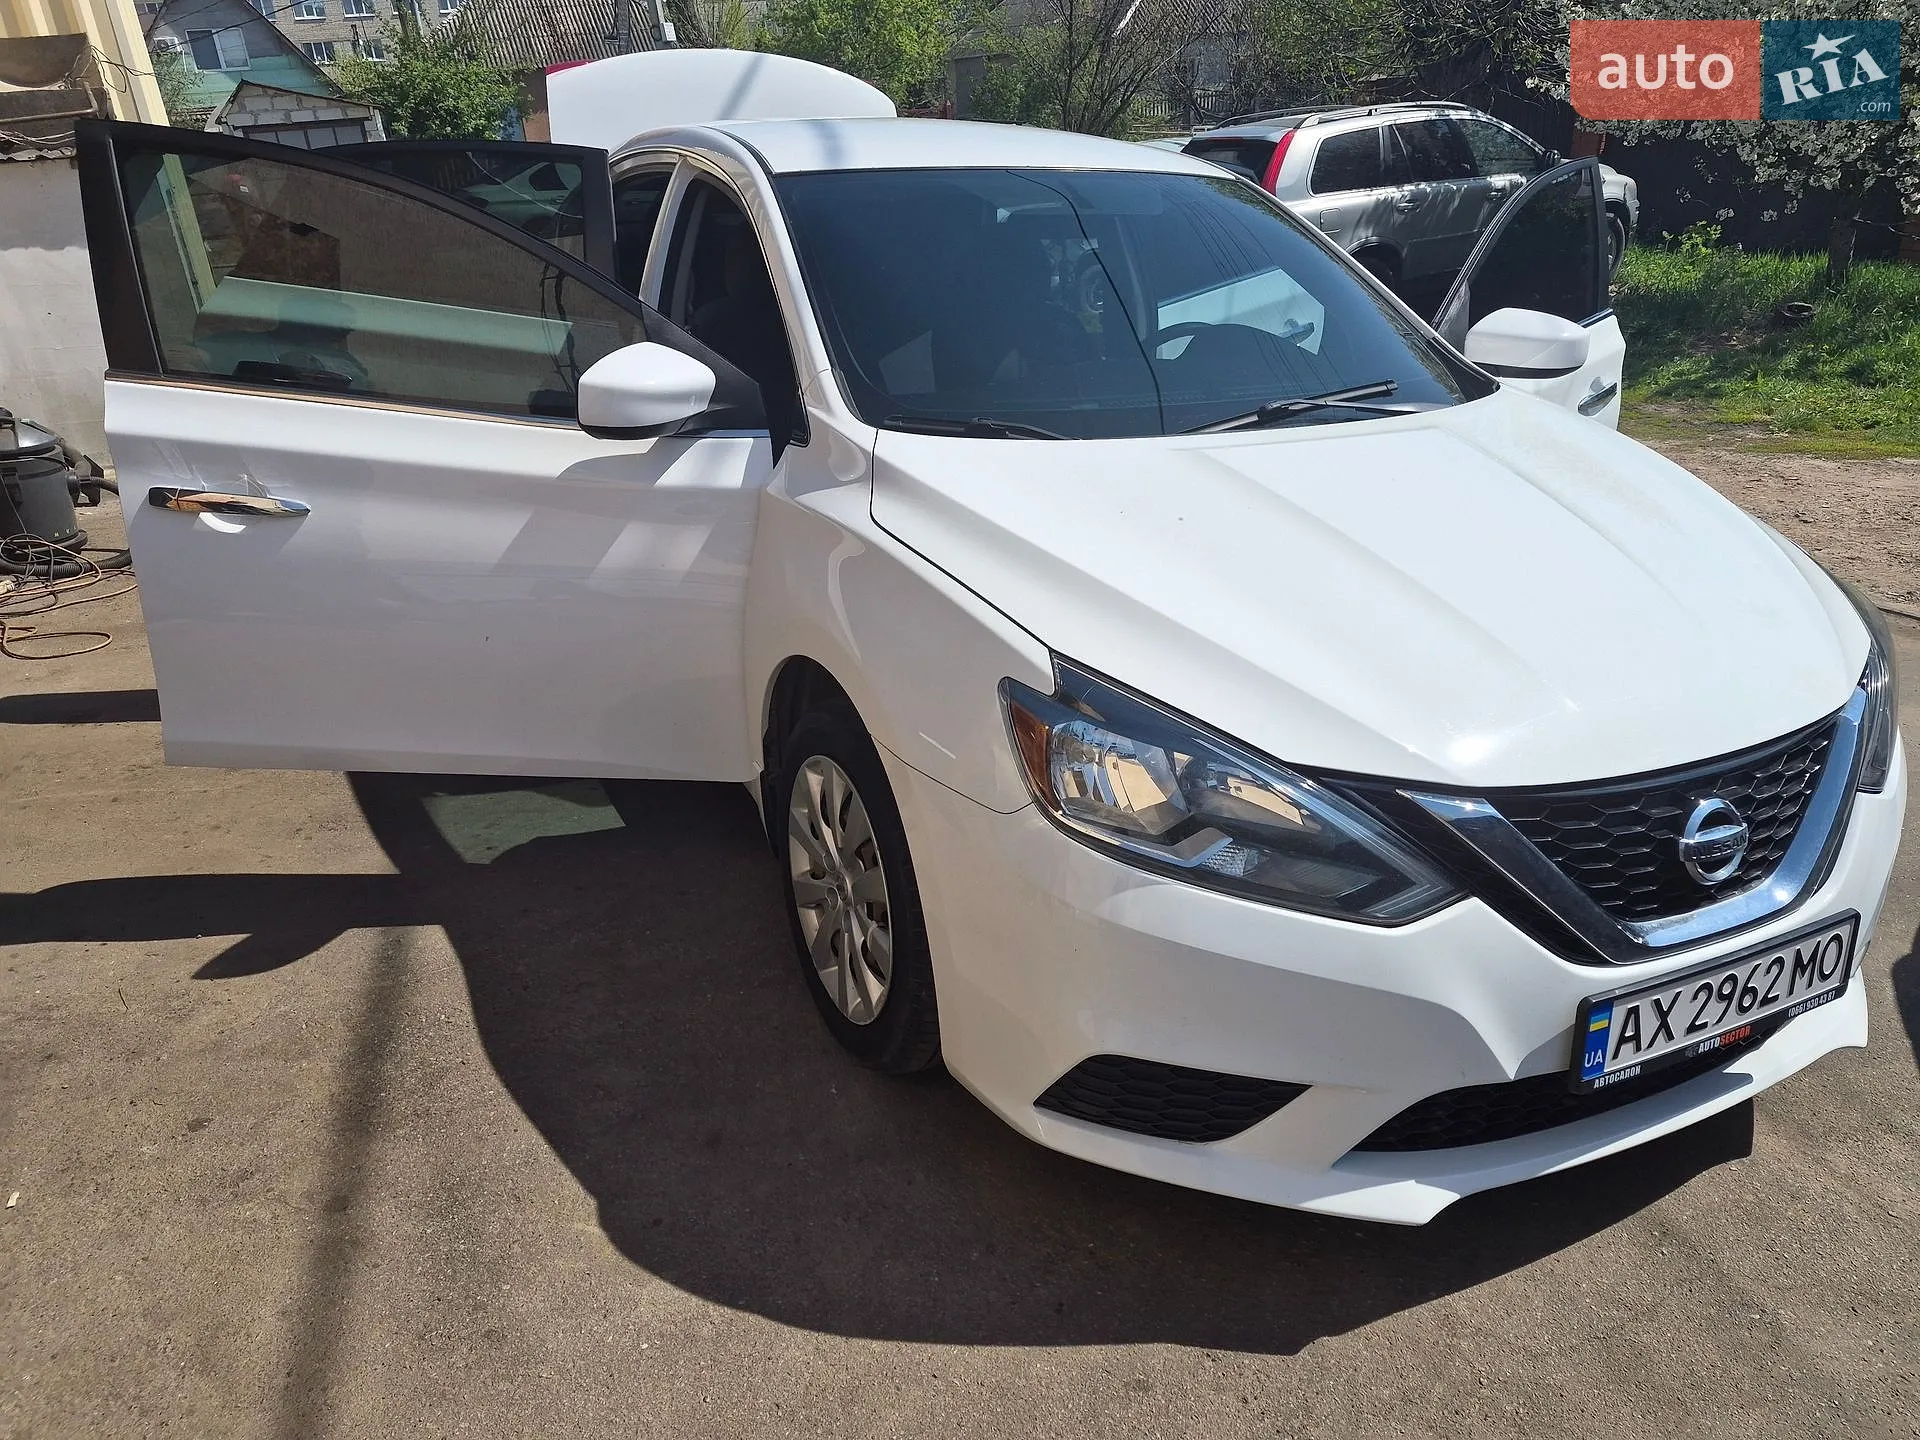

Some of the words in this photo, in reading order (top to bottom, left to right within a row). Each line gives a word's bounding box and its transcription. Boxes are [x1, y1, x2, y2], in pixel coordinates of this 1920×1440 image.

[1611, 990, 1683, 1061] AX
[1683, 956, 1786, 1036] 2962
[1787, 932, 1844, 998] MO
[1806, 997, 1819, 1010] 930
[1819, 993, 1828, 1004] 43
[1827, 990, 1836, 1001] 87
[1698, 1025, 1752, 1055] AUTOSECTOR
[1584, 1049, 1605, 1068] UA
[1593, 1065, 1642, 1089] АВТОСАЛОН
